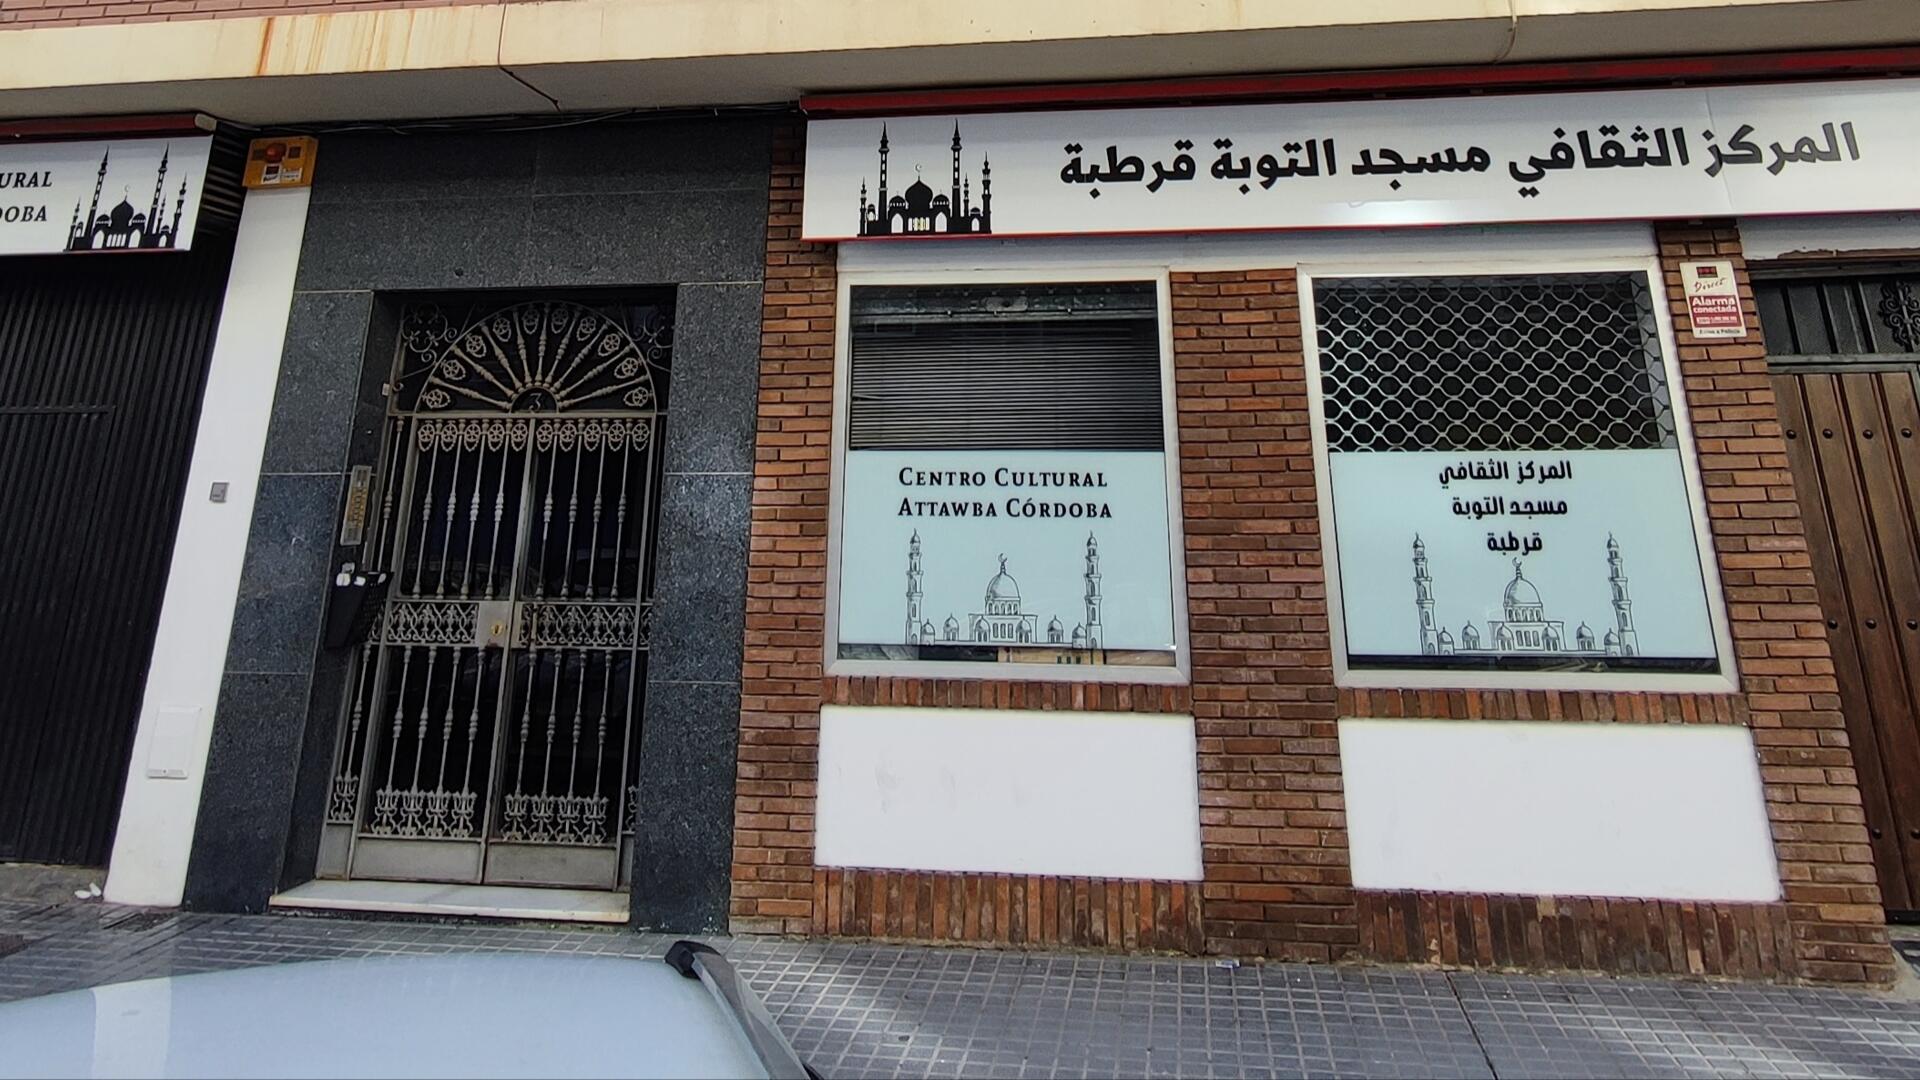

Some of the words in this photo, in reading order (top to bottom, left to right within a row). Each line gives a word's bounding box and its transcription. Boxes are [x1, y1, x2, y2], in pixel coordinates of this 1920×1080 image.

[1508, 124, 1690, 198] الثقافي
[1701, 121, 1861, 178] المركز
[1060, 138, 1196, 200] قرطبة
[1210, 137, 1337, 195] التوبة
[1351, 146, 1491, 191] مسجد
[0, 205, 47, 223] OBA
[1692, 296, 1736, 306] Alarma
[1693, 305, 1737, 314] conectada
[898, 466, 986, 487] CENTRO
[994, 467, 1108, 488] CULTURAL
[1438, 458, 1510, 490] الثقافي
[1516, 460, 1573, 485] المركز
[897, 497, 998, 517] ATTAWBA
[1005, 497, 1112, 519] CÓRDOBA
[1452, 496, 1505, 521] التوبة
[1509, 500, 1568, 520] مسجد
[1487, 530, 1543, 557] قرطبة
